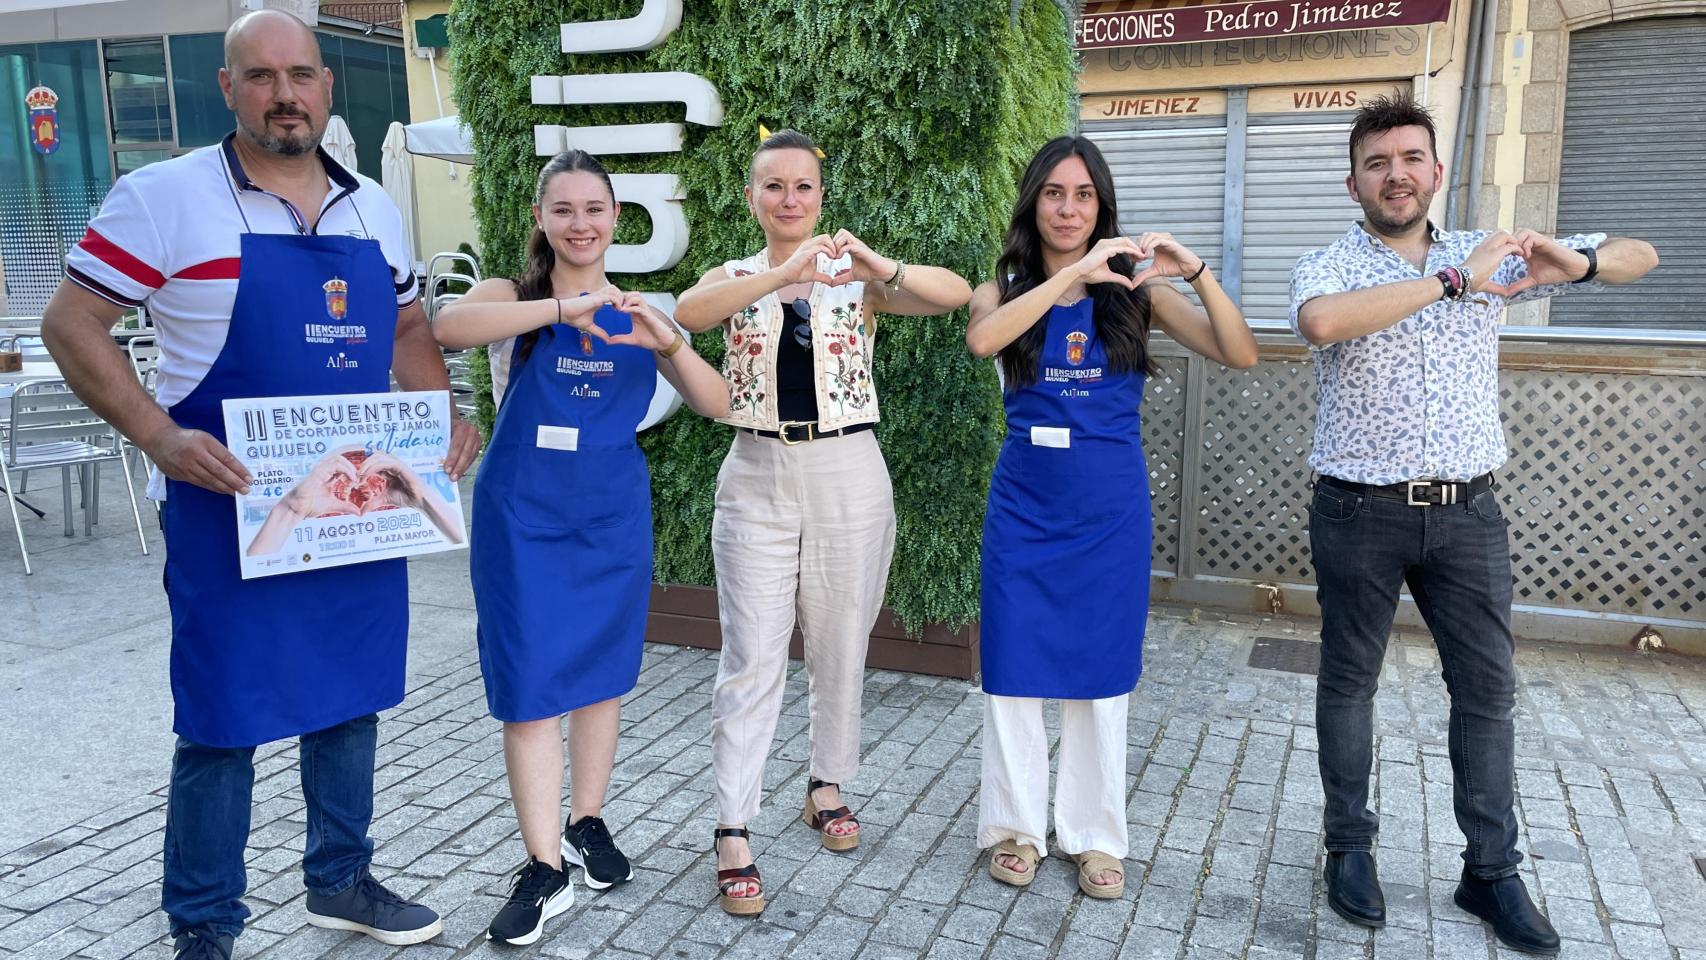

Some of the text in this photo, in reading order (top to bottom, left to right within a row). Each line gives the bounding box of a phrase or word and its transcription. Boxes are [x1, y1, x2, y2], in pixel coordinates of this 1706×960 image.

[1203, 3, 1279, 33] Pedro
[1283, 0, 1402, 33] Jiménez
[1103, 90, 1357, 117] JIMENEZ VIVAS
[316, 324, 366, 334] ENCUENTRO
[567, 359, 613, 368] ENCUENTRO
[1054, 368, 1101, 377] ENCUENTRO
[243, 401, 431, 442] II ENCUENTRO
[275, 429, 292, 440] DE
[296, 423, 380, 438] CORTADORES
[383, 422, 398, 433] DE
[246, 441, 327, 458] GUIJUELO
[365, 428, 444, 457] solidario
[257, 470, 283, 478] PLATO
[263, 486, 283, 497] 4 €
[295, 512, 422, 542] 11 AGOSTO 2024
[374, 529, 436, 545] PLAZA MAYOR
